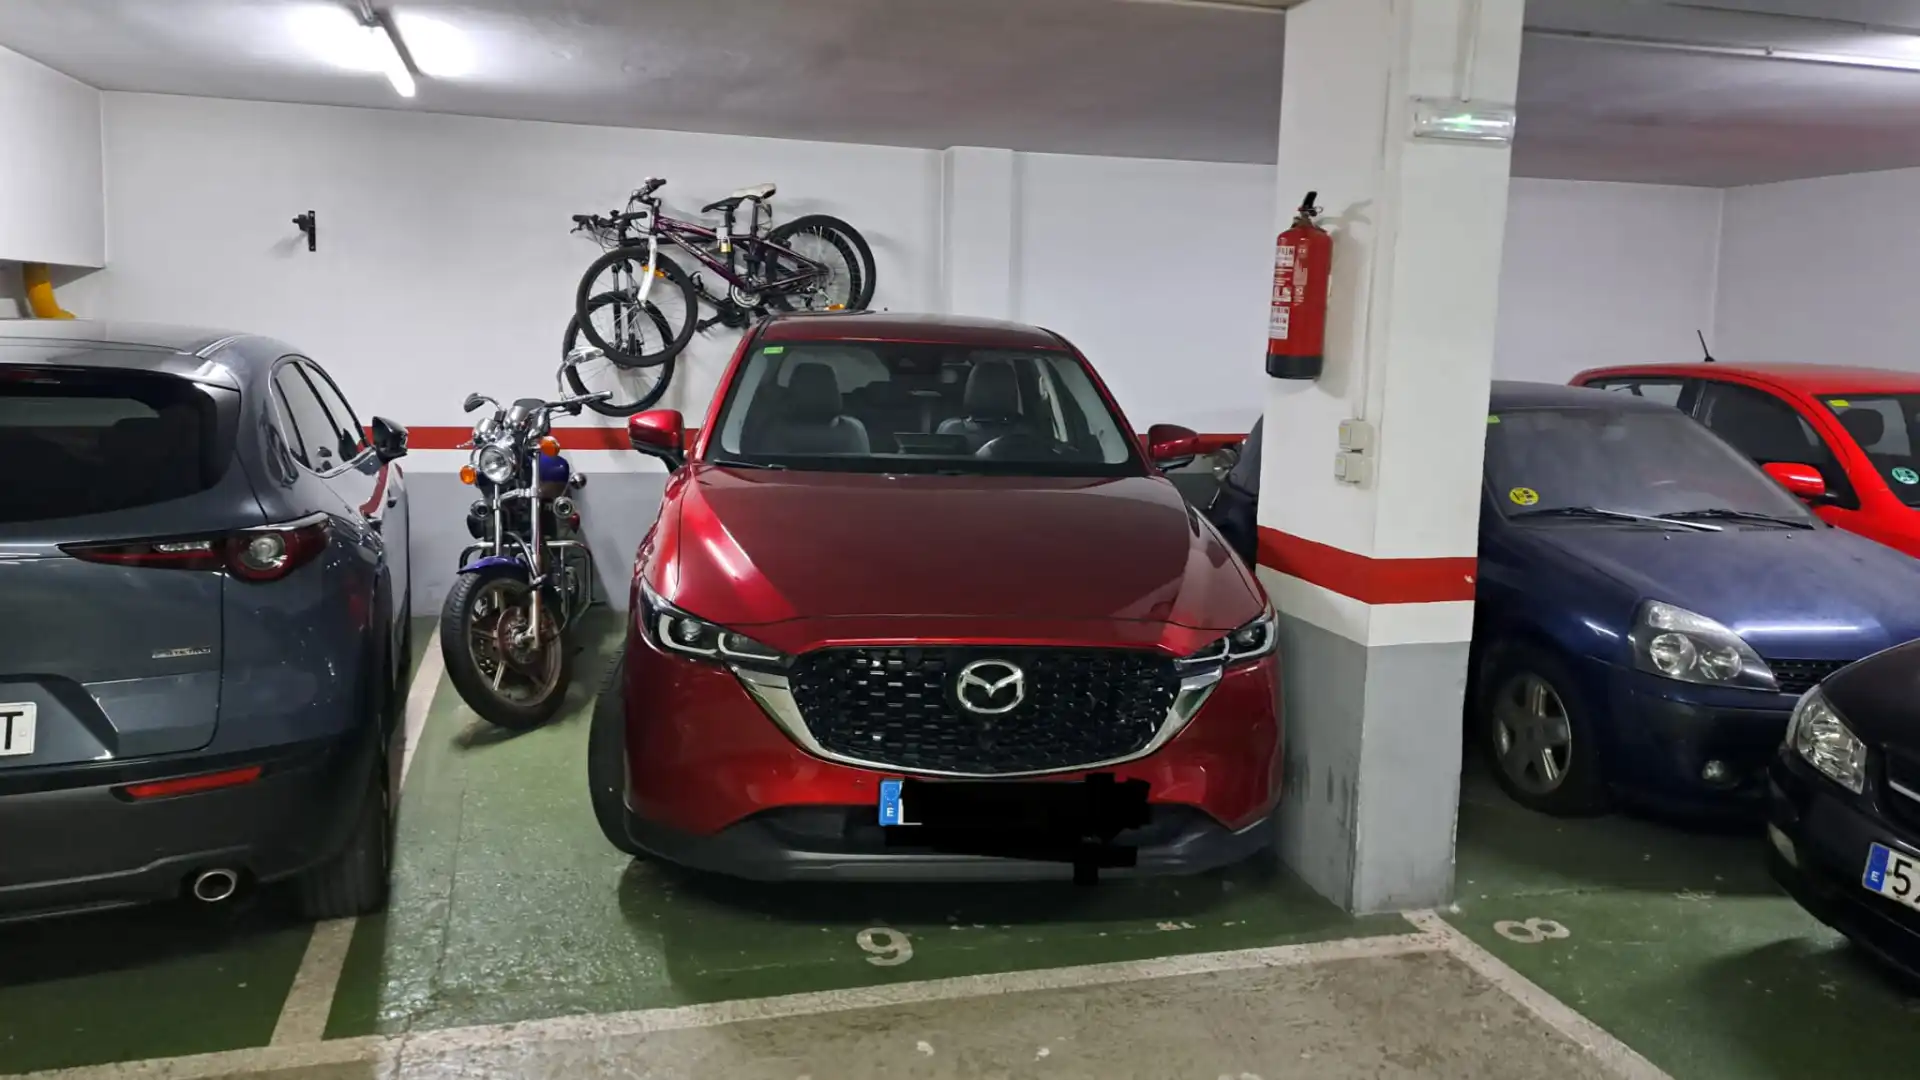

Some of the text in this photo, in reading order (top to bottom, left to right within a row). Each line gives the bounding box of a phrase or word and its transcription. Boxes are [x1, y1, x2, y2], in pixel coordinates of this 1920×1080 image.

[0, 711, 24, 750] T
[886, 807, 895, 817] E
[1870, 858, 1920, 903] E 5
[856, 926, 914, 966] 9
[1493, 916, 1571, 943] 8
